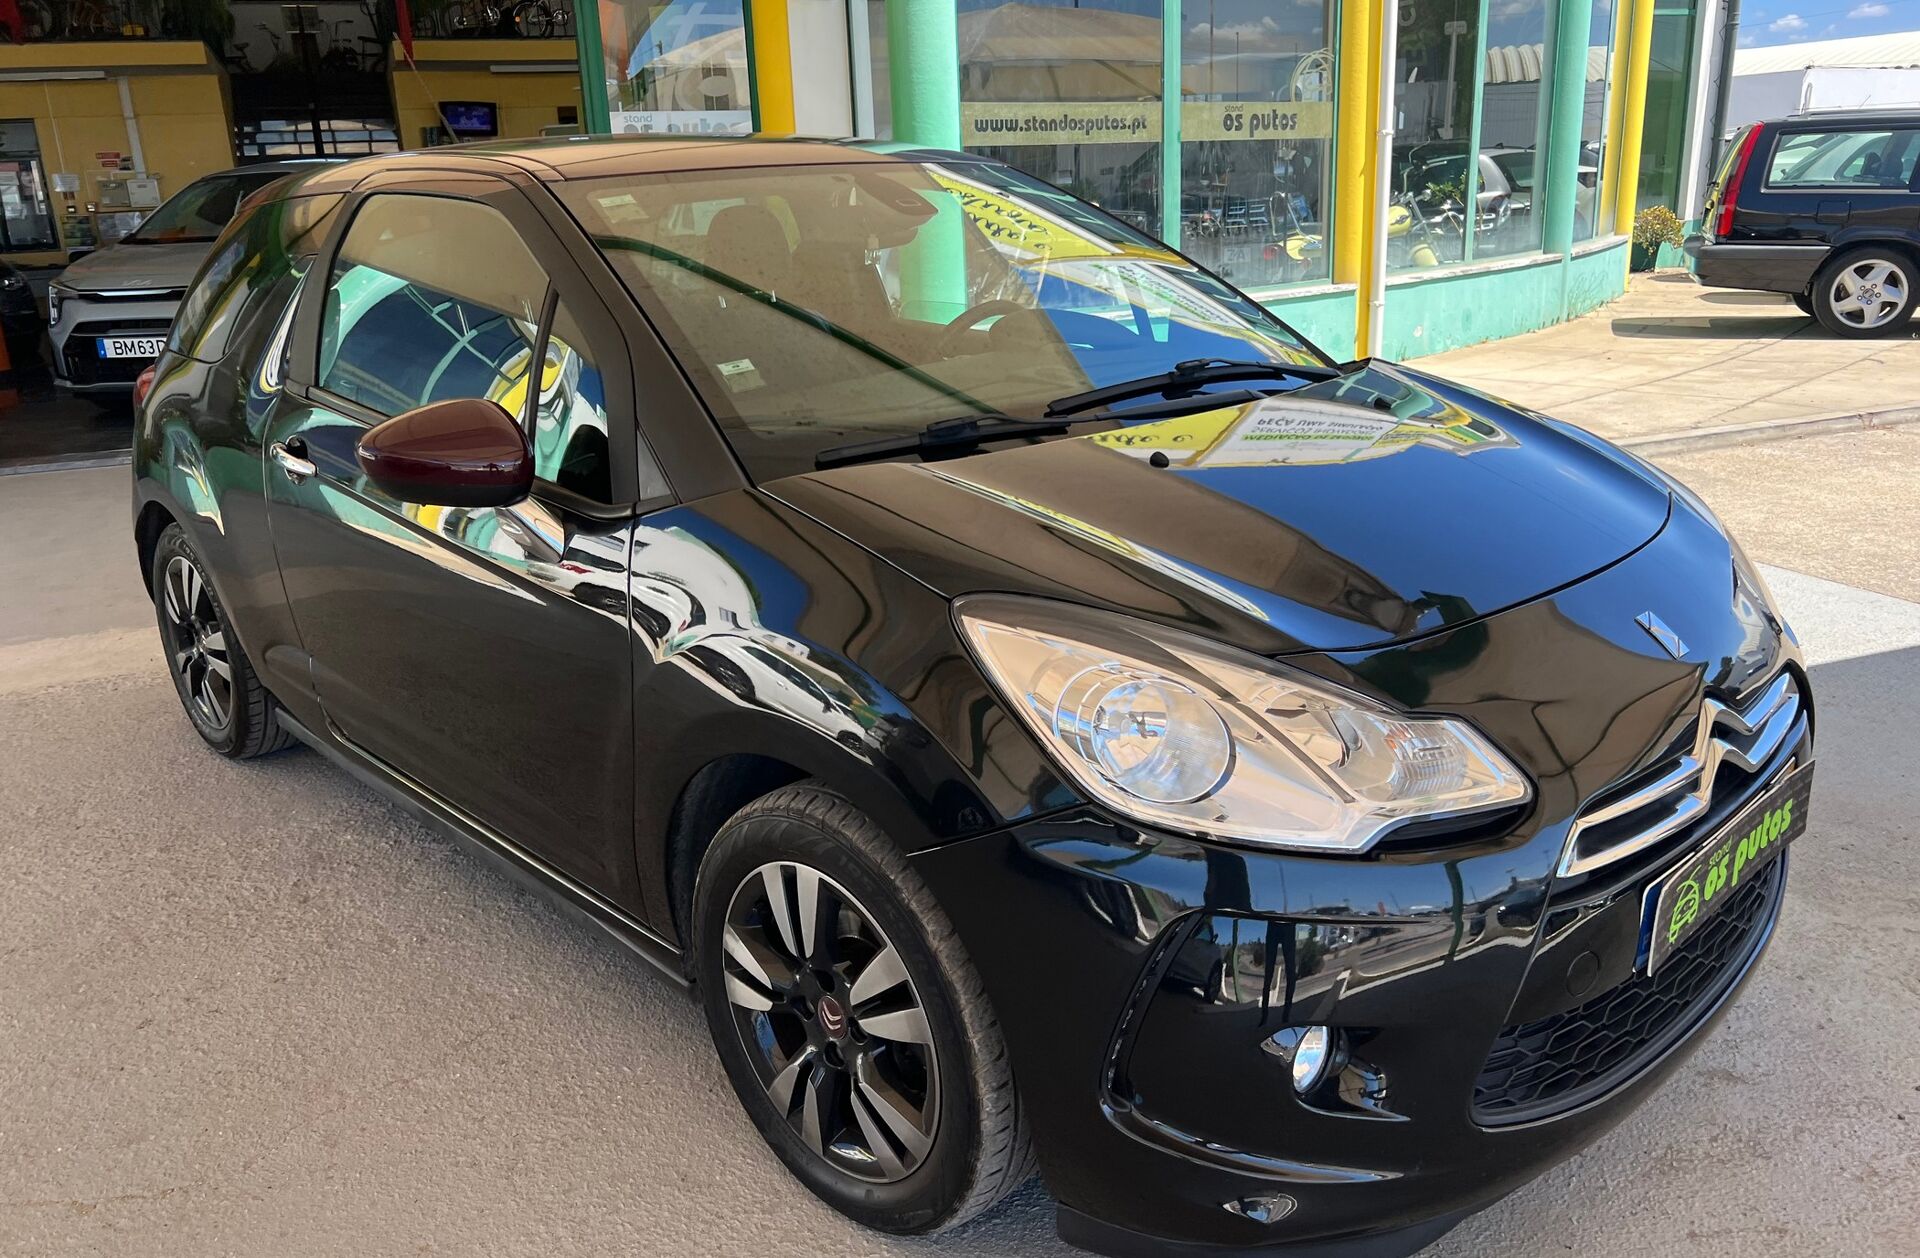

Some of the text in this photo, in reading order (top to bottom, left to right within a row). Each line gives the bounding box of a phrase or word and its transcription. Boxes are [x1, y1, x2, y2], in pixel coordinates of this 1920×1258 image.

[623, 114, 653, 124] stand
[974, 114, 1148, 136] www.standosputos.pt
[1223, 108, 1297, 138] os putos
[1704, 798, 1793, 901] os putos
